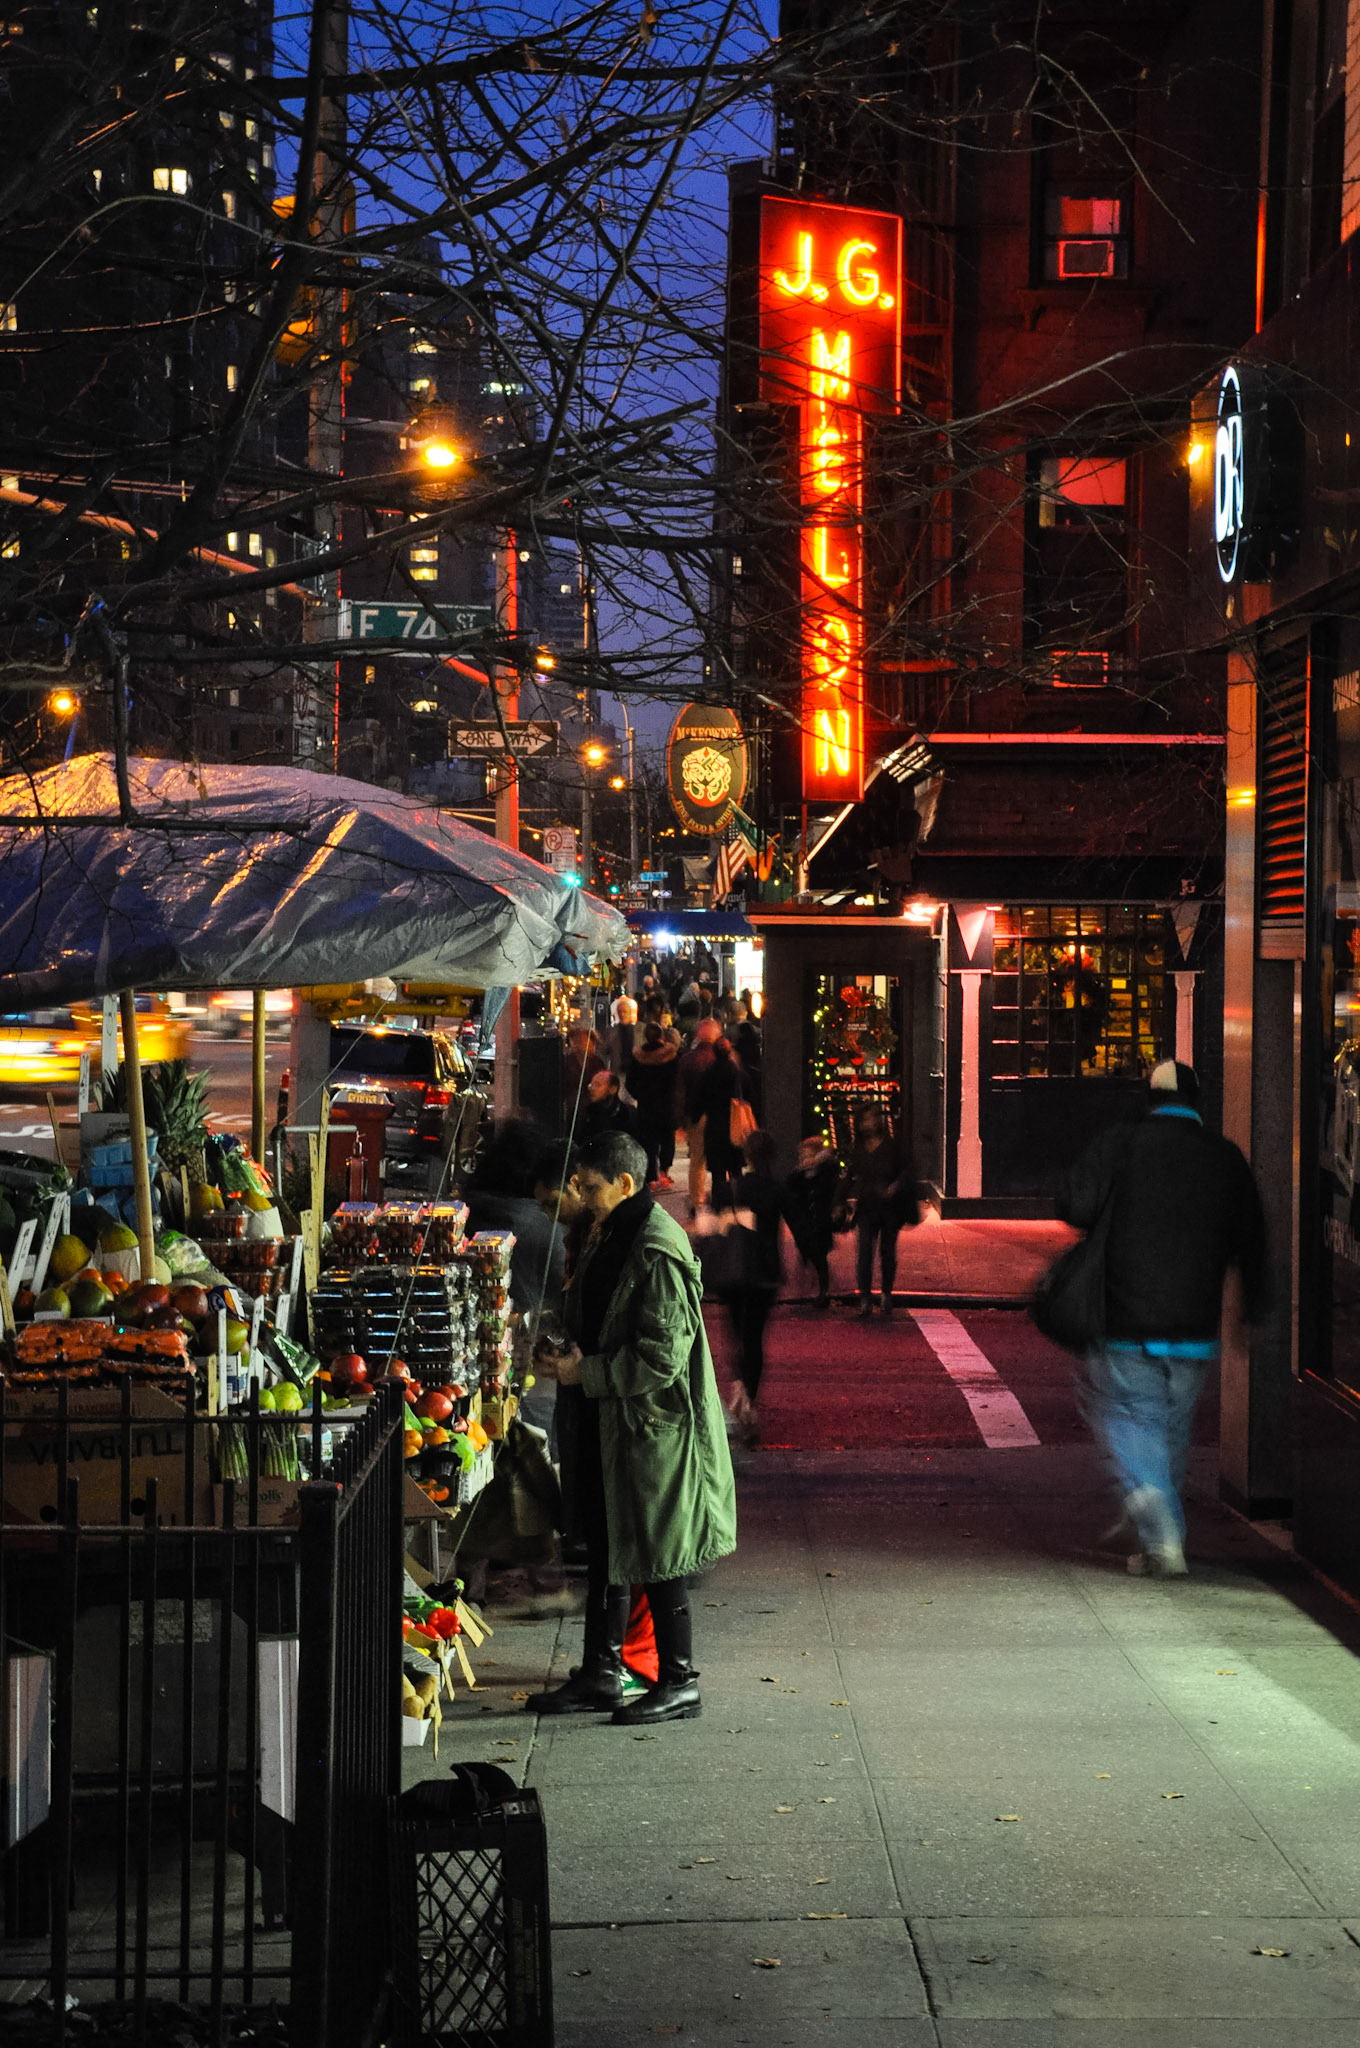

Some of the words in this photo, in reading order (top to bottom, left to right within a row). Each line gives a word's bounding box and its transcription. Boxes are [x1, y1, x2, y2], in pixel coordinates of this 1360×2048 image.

[810, 327, 850, 777] MELON
[396, 610, 437, 640] 74
[455, 612, 477, 631] ST
[465, 731, 496, 746] ONE
[508, 732, 541, 746] WAY
